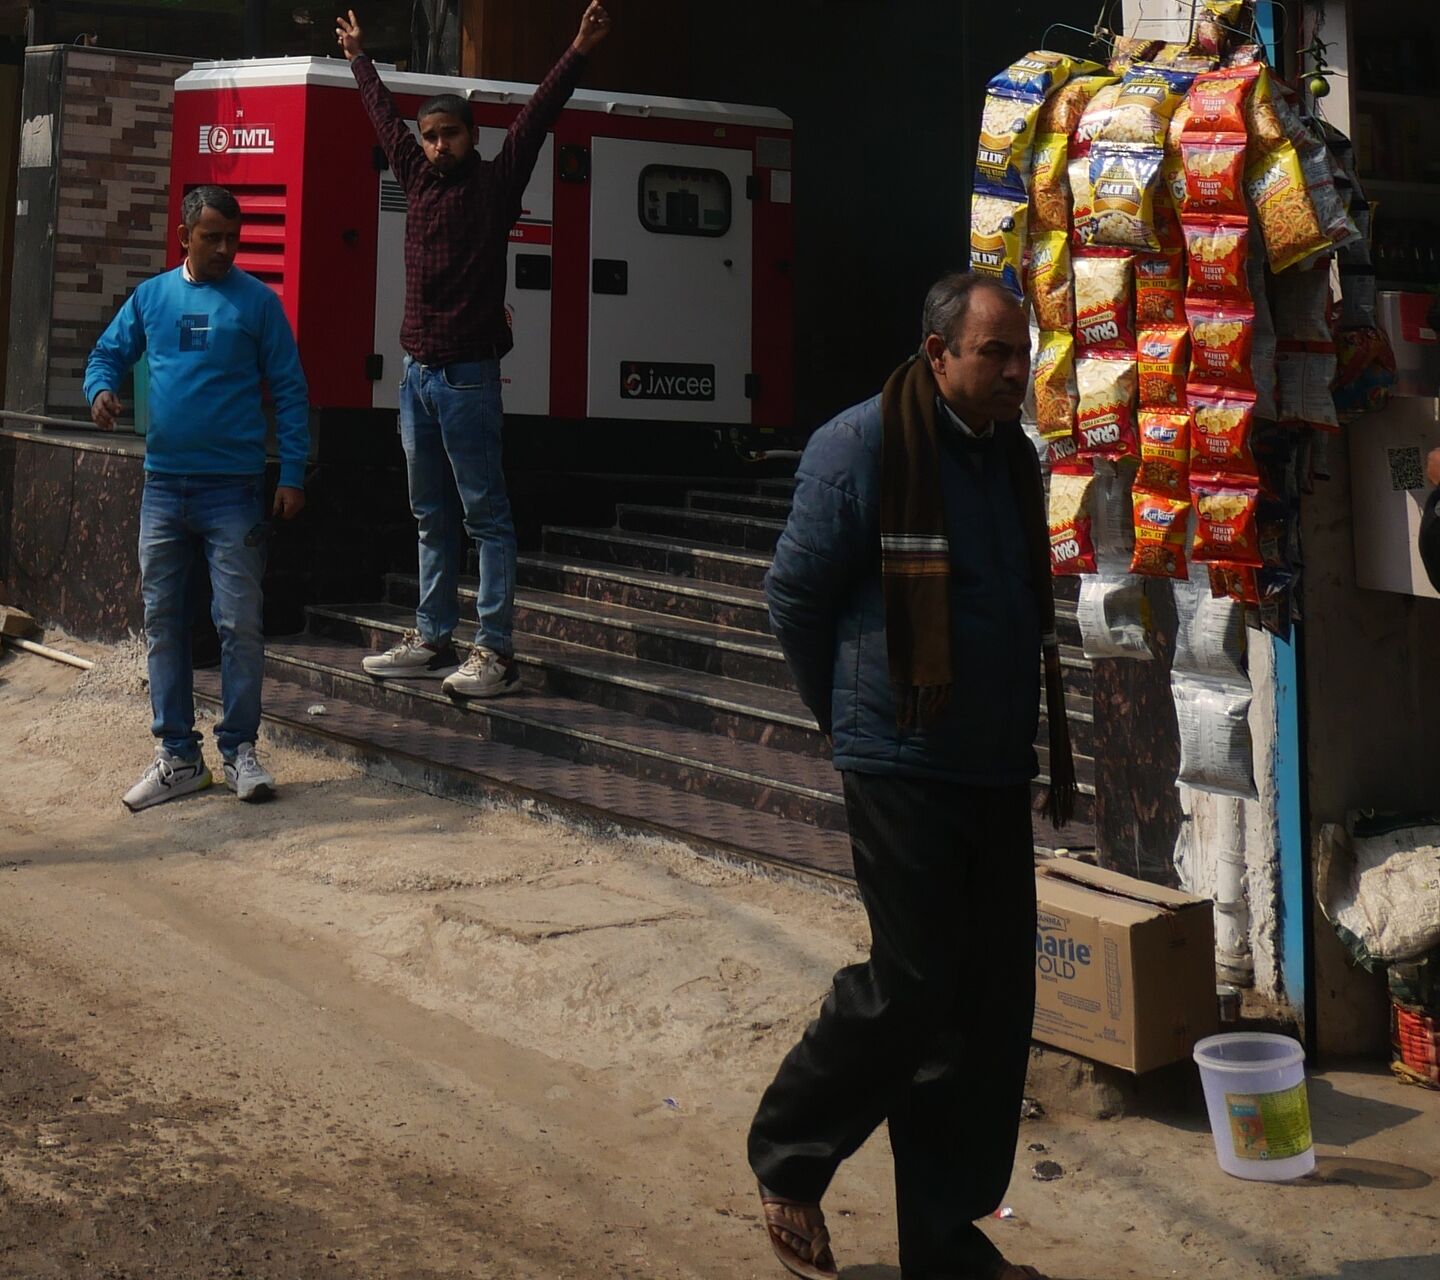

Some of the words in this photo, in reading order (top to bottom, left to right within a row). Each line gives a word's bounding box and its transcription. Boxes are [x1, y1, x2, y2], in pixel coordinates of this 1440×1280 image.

[233, 129, 274, 146] TMTL
[1080, 321, 1119, 345] CRAX
[1084, 423, 1120, 448] CRAX
[1051, 437, 1077, 459] CRAX
[1051, 540, 1080, 563] CRAX
[1036, 954, 1076, 980] OLD
